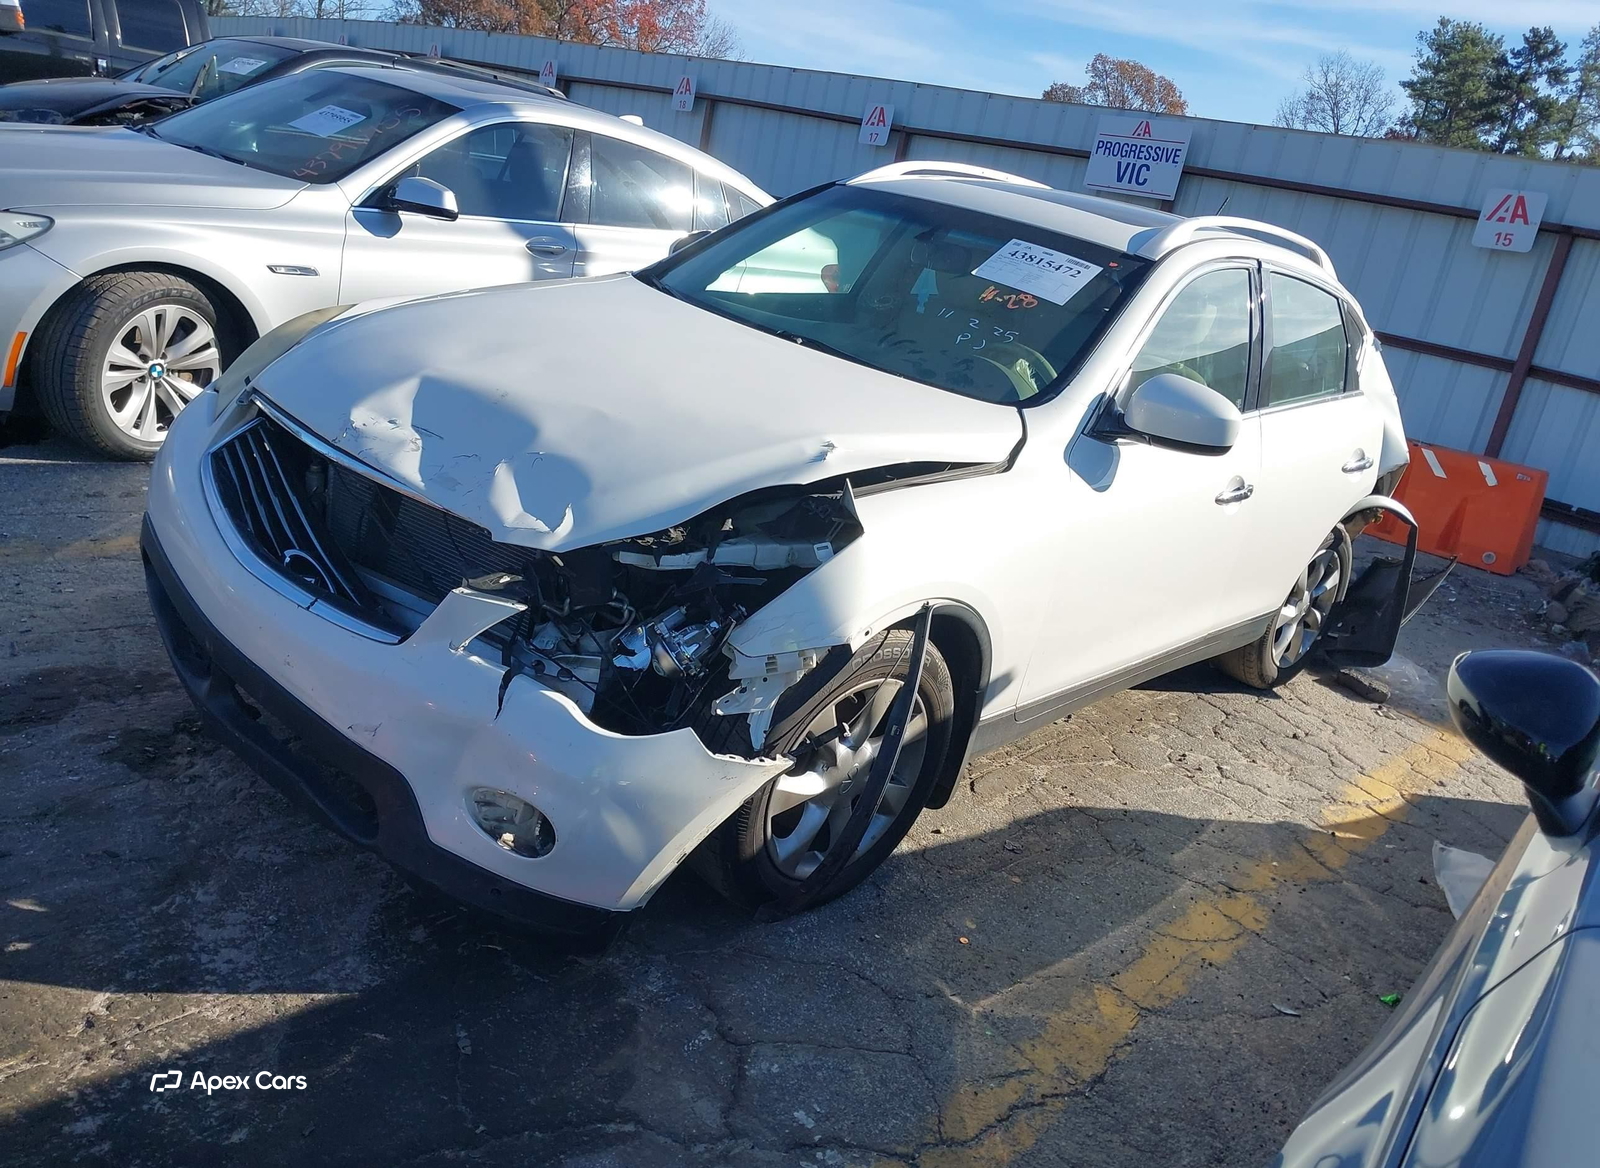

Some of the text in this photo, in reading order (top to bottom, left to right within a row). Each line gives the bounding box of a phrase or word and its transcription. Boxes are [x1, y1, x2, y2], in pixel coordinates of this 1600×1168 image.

[679, 100, 687, 109] 18
[869, 132, 879, 143] 17
[1095, 140, 1182, 164] PROGRESSIVE
[1116, 161, 1150, 186] VIC
[1494, 232, 1514, 247] 15
[1008, 250, 1082, 278] 43815472
[969, 318, 979, 329] 2
[993, 326, 1019, 343] 25
[851, 647, 932, 671] CROSSOR
